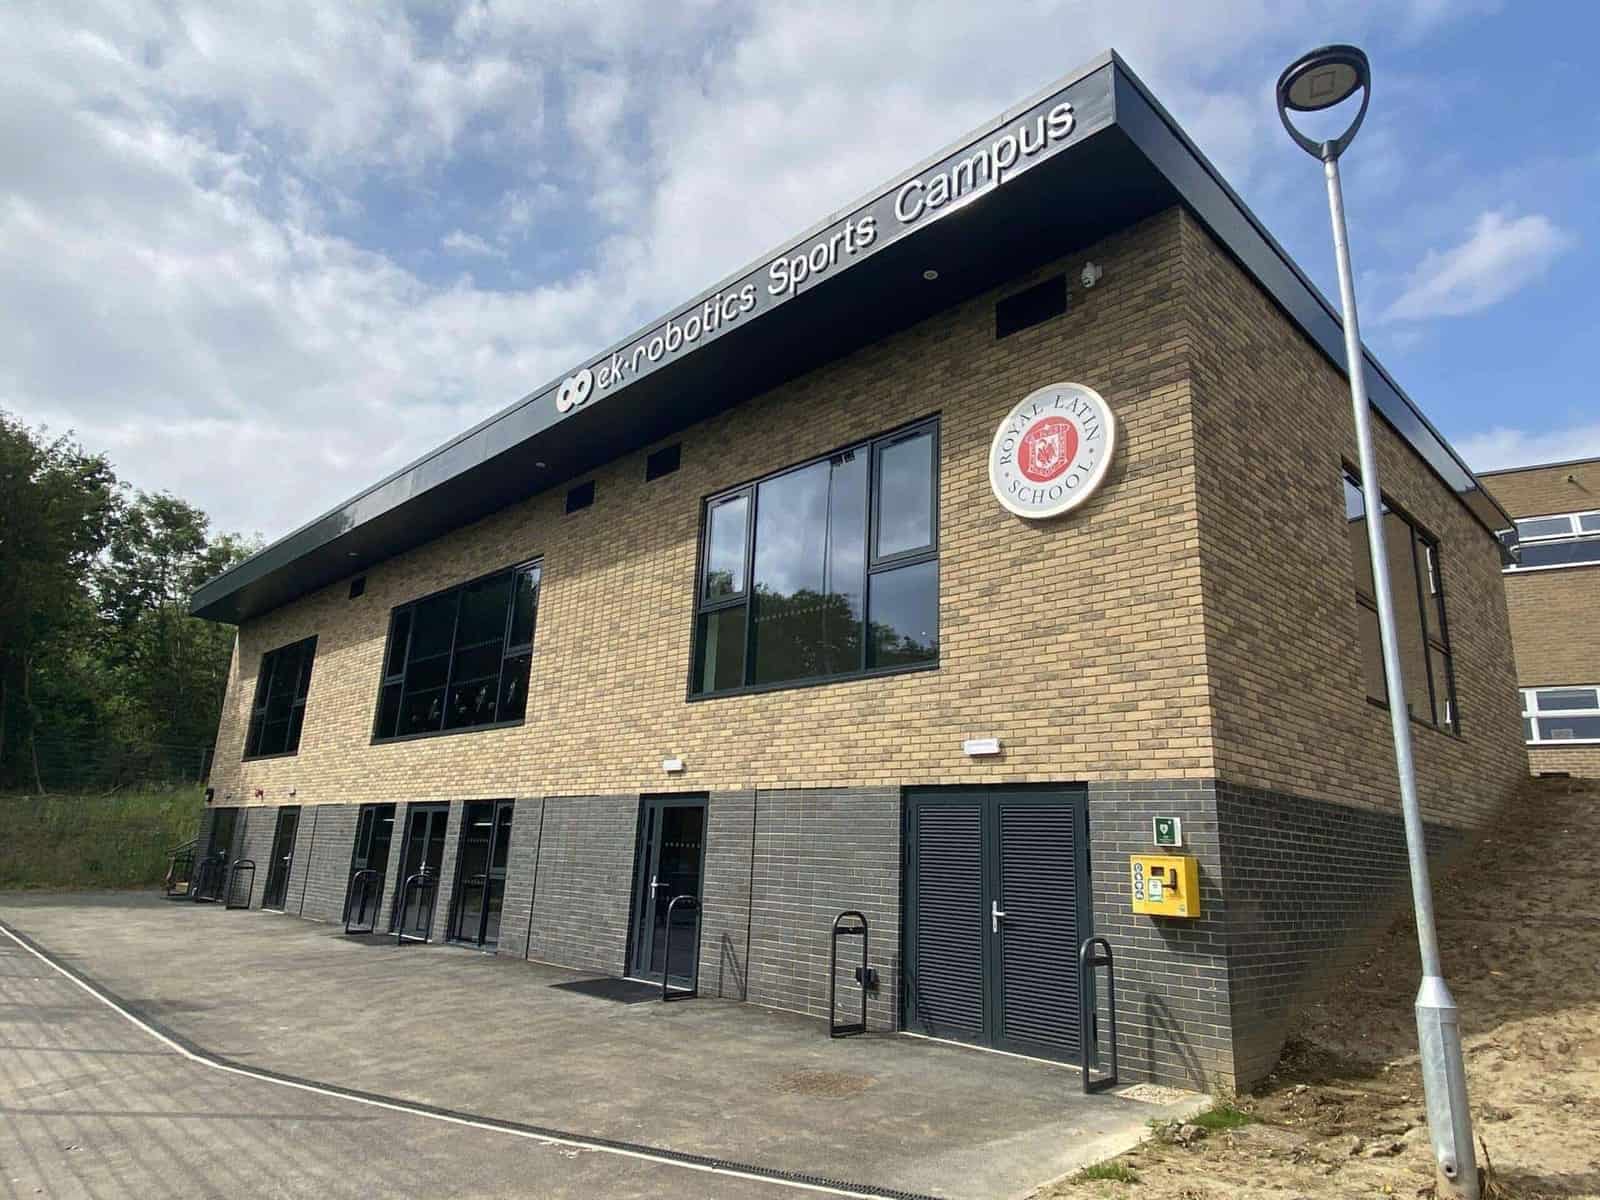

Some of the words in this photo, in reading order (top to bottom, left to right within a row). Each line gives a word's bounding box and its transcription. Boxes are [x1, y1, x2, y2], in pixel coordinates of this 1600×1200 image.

[767, 216, 875, 295] Sports
[895, 102, 1074, 222] Campus
[1000, 404, 1044, 465] ROYAL
[1053, 394, 1100, 442] LATIN
[1008, 461, 1093, 504] SCHOOL
